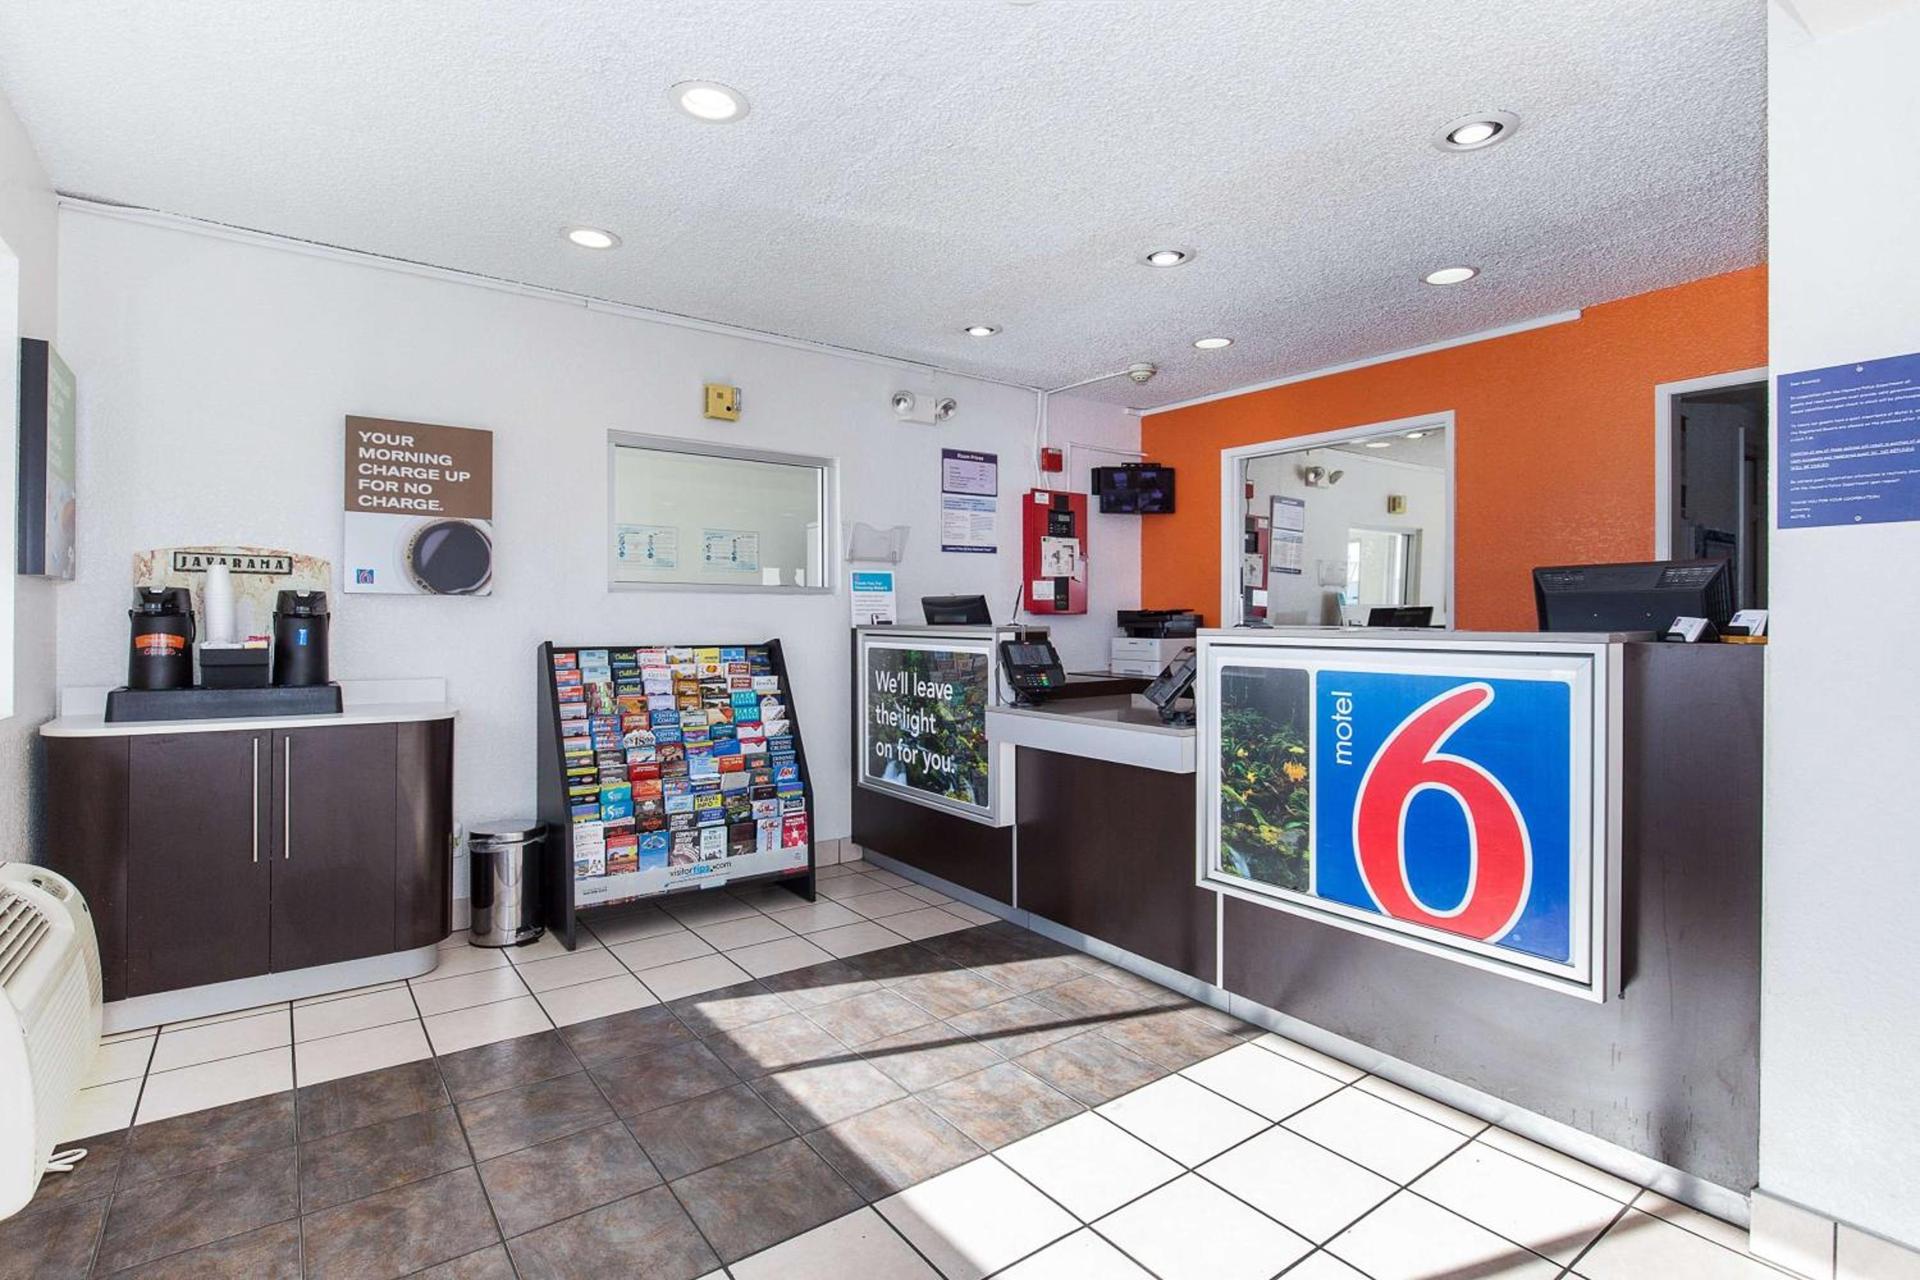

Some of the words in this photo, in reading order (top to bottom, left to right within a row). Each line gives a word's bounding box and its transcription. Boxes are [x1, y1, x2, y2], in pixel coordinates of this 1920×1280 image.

[358, 430, 415, 447] YOUR
[358, 447, 453, 466] MORNING
[358, 463, 440, 481] CHARGE
[445, 470, 471, 482] UP
[358, 479, 399, 493] FOR
[404, 482, 433, 495] NO
[358, 495, 445, 511] CHARGE.
[875, 670, 908, 695] We'll
[914, 672, 953, 700] leave
[875, 703, 898, 726] the
[902, 705, 937, 738] light
[875, 741, 893, 759] on
[897, 738, 918, 765] for
[1330, 690, 1353, 766] motel
[1352, 681, 1533, 943] 6
